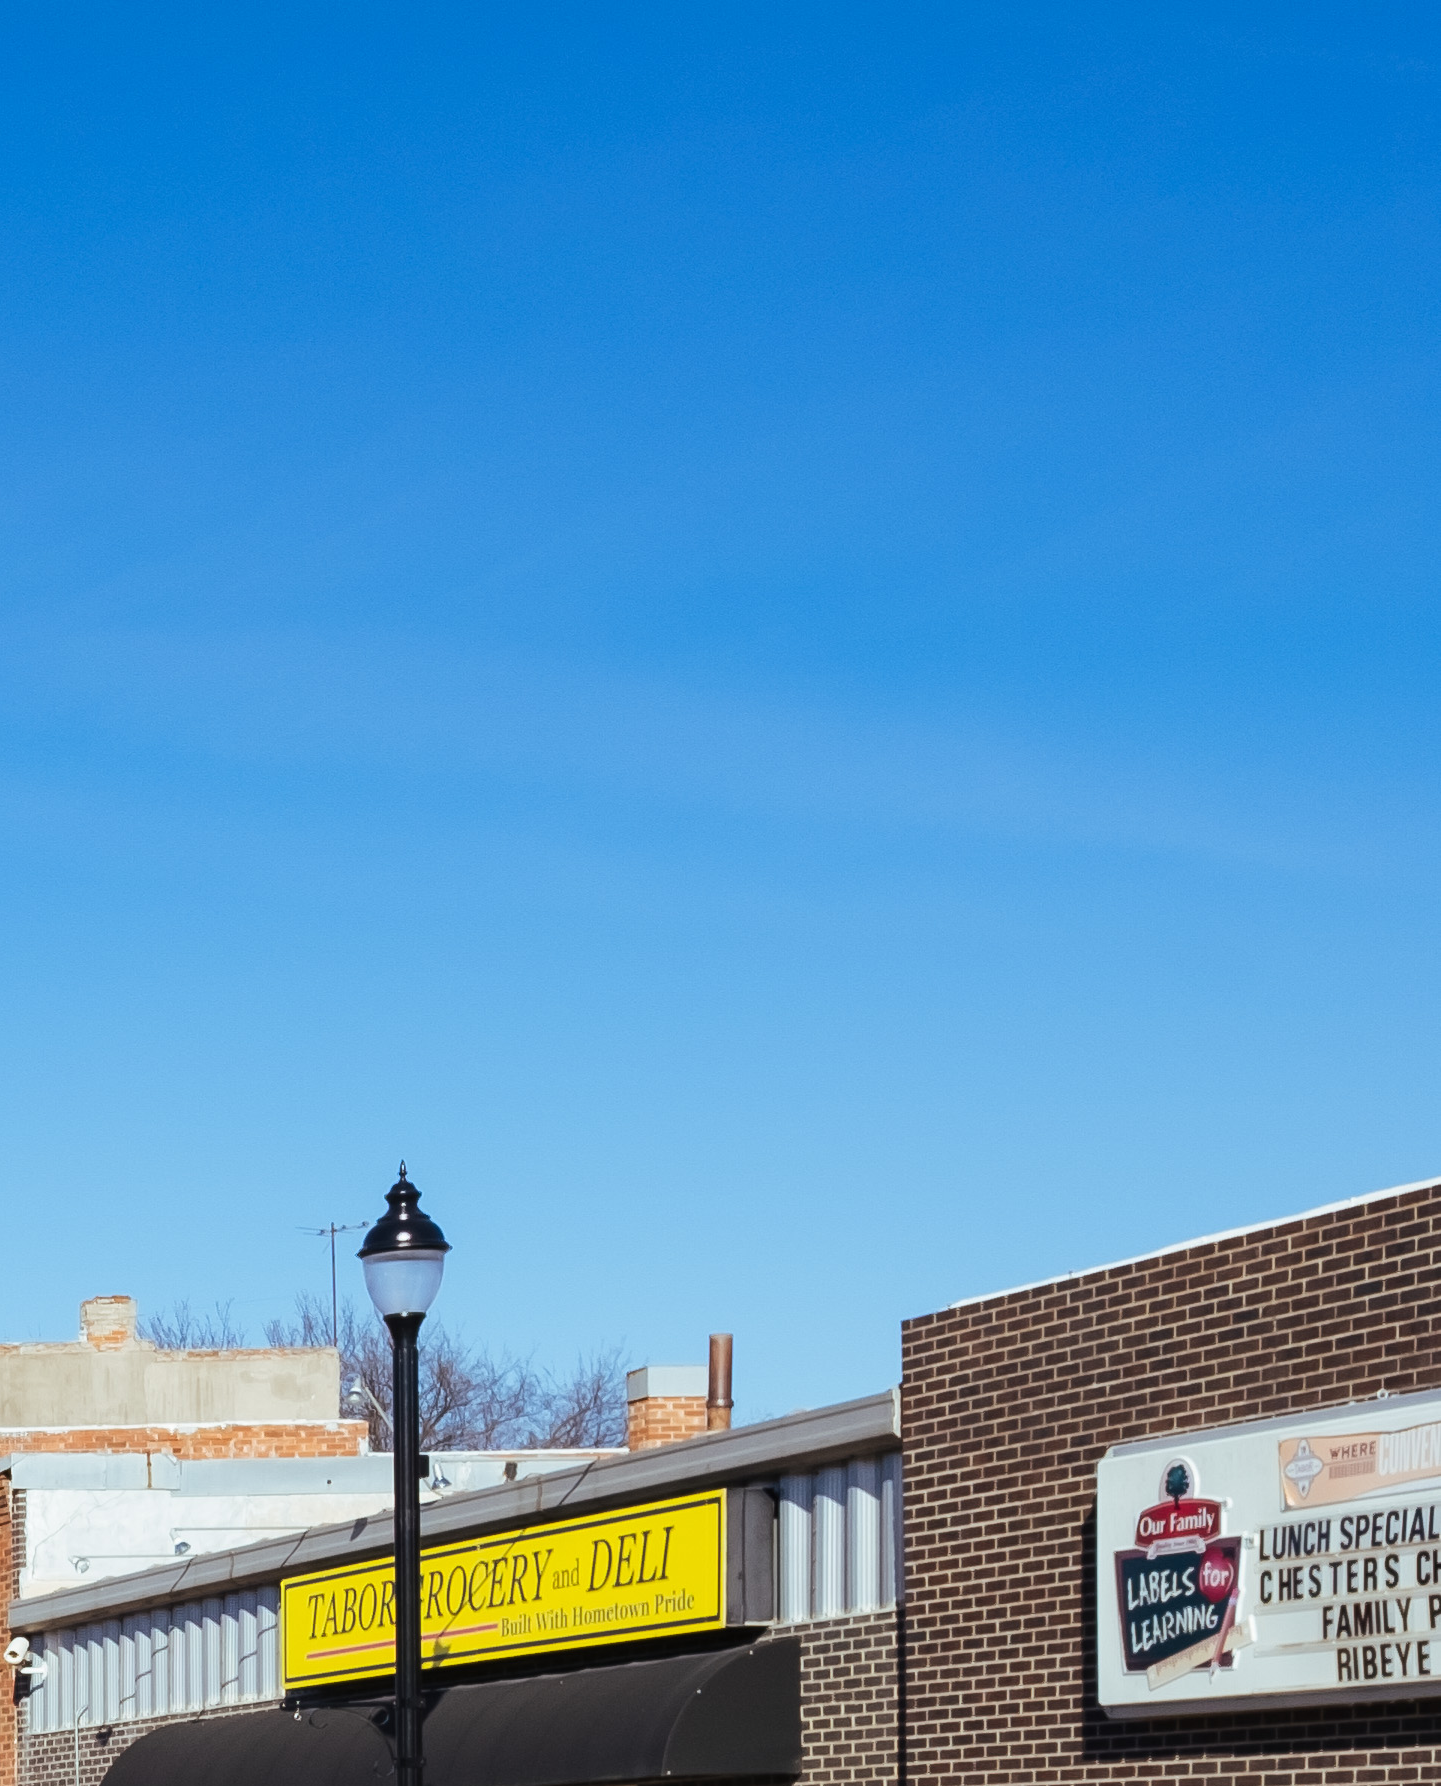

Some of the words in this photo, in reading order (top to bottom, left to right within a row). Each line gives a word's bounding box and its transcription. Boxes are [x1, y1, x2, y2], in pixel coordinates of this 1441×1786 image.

[1329, 1440, 1376, 1460] WHERE
[1139, 1516, 1166, 1537] Our
[1170, 1507, 1215, 1534] Family
[1259, 1518, 1331, 1562] LUNCH
[1340, 1505, 1440, 1551] SPECIAL
[307, 1579, 395, 1640] TABOR
[420, 1548, 554, 1621] ROCERY
[551, 1557, 581, 1590] and
[586, 1525, 675, 1593] DELI
[1127, 1566, 1196, 1611] LABELS
[1202, 1561, 1230, 1588] for
[1260, 1553, 1400, 1604] CHESTERS
[501, 1611, 532, 1637] Built
[535, 1609, 568, 1631] With
[572, 1600, 650, 1627] Hometown
[654, 1589, 696, 1615] Pride
[1131, 1604, 1219, 1654] LEARNING
[1322, 1597, 1412, 1640] FAMILY
[1336, 1640, 1431, 1682] RIBEYE
